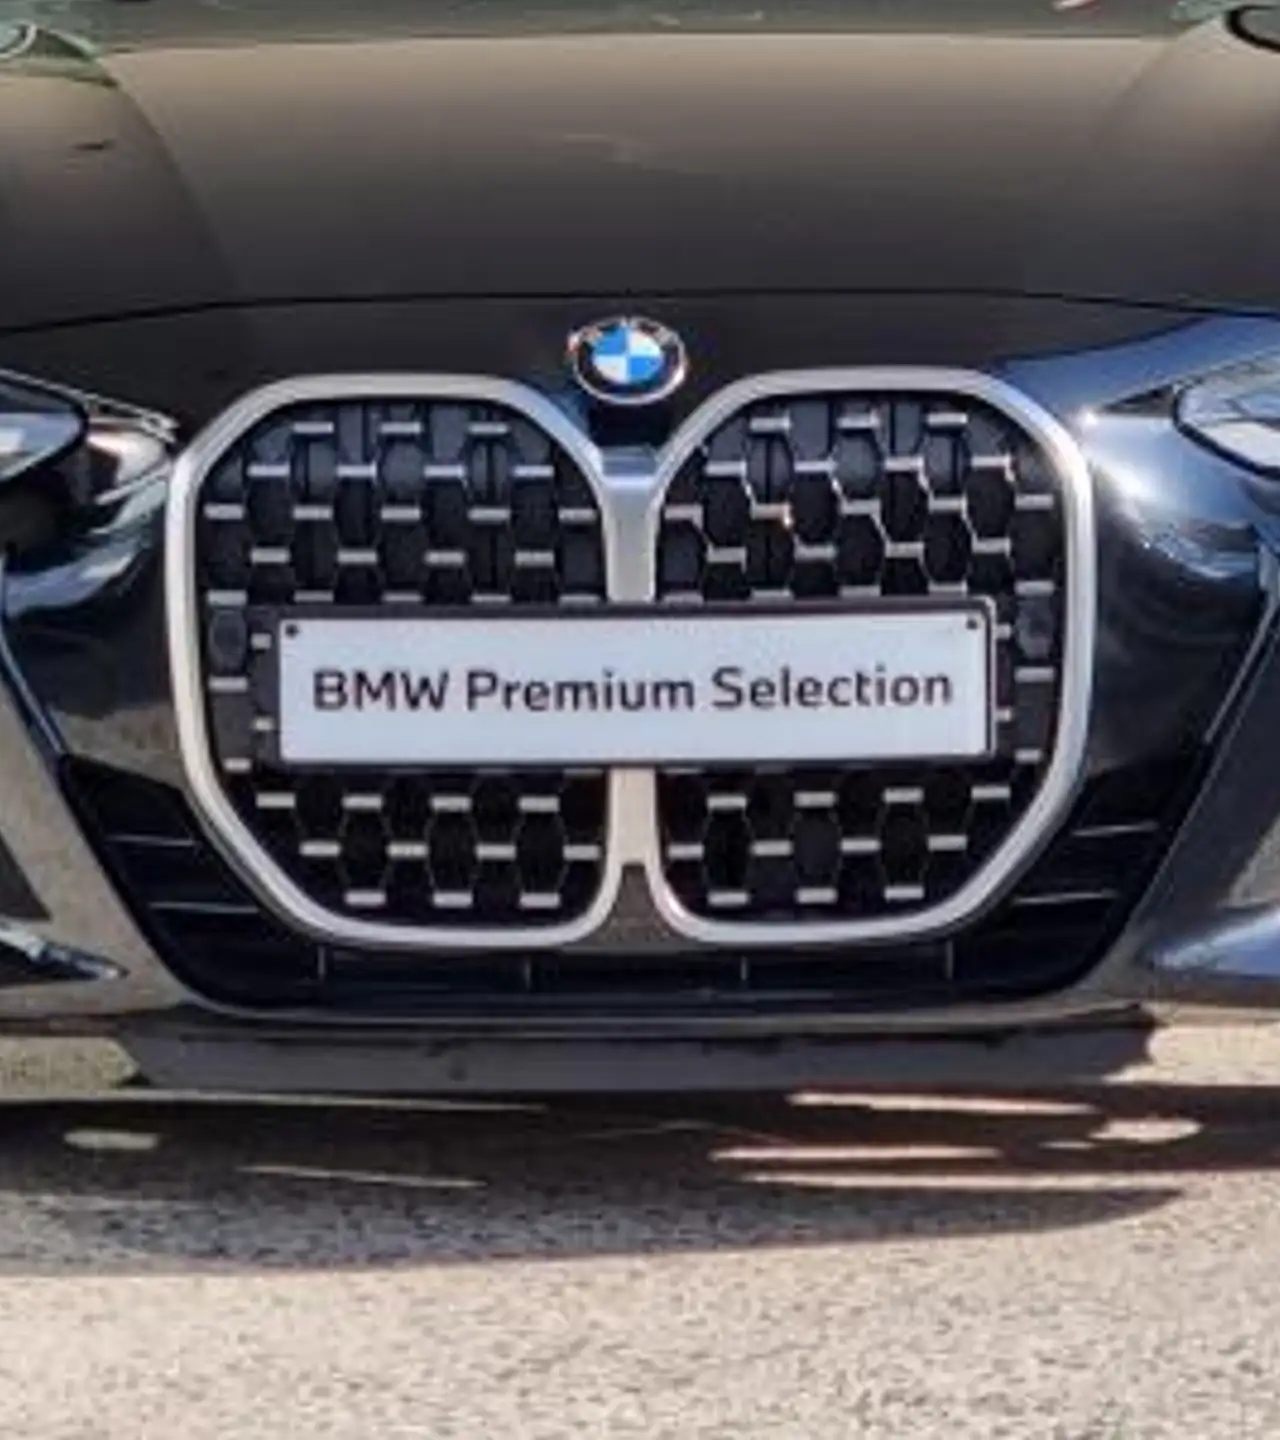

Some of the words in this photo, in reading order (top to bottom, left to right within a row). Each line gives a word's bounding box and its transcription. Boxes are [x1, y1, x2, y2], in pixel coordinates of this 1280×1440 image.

[313, 669, 450, 711] BMW
[466, 669, 695, 712] Premium
[711, 665, 952, 710] Selection
